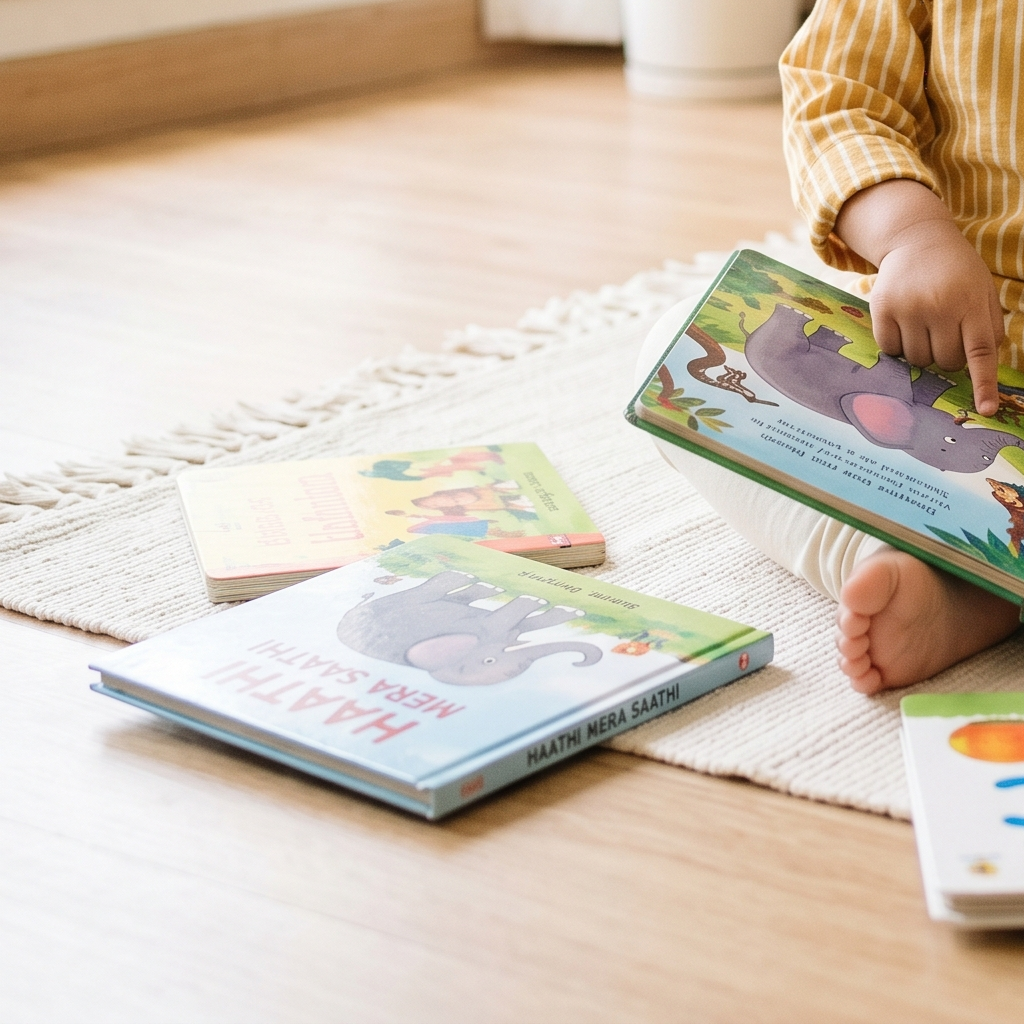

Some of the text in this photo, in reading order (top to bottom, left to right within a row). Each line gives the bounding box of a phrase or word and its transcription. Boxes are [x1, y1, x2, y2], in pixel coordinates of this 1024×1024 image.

[204, 660, 420, 744] HAATHI
[247, 639, 465, 719] MERA SAATHI
[526, 682, 680, 767] HAATHI MERA SAATHI
